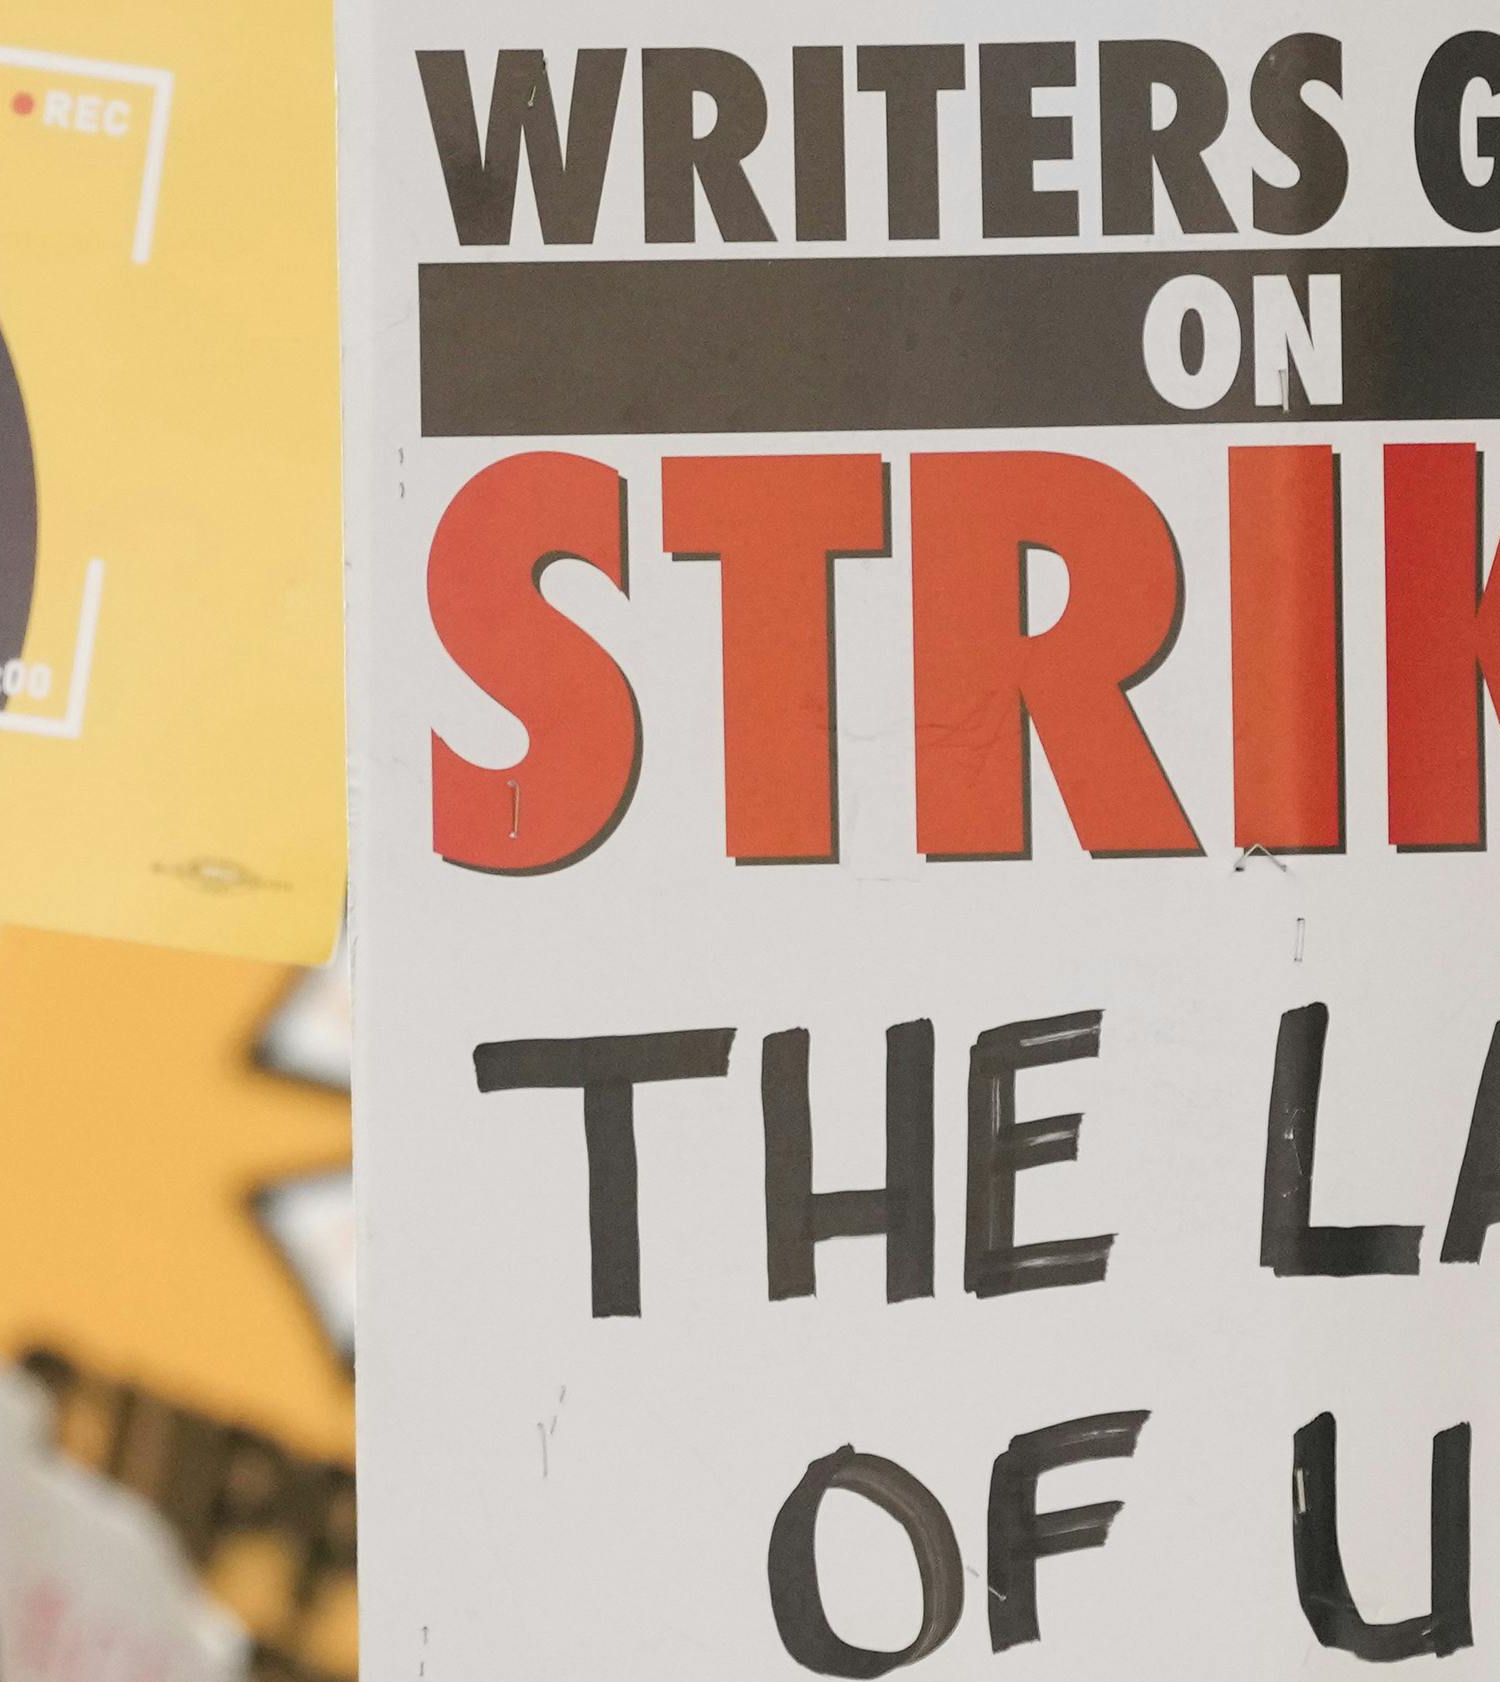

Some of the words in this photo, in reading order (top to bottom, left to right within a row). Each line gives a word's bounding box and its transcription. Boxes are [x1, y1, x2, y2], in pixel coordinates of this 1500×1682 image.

[44, 89, 130, 137] REC
[415, 31, 1349, 247] WRITERS
[1142, 273, 1342, 409] ON
[473, 1009, 1118, 1319] THE
[767, 1409, 1151, 1680] OF
